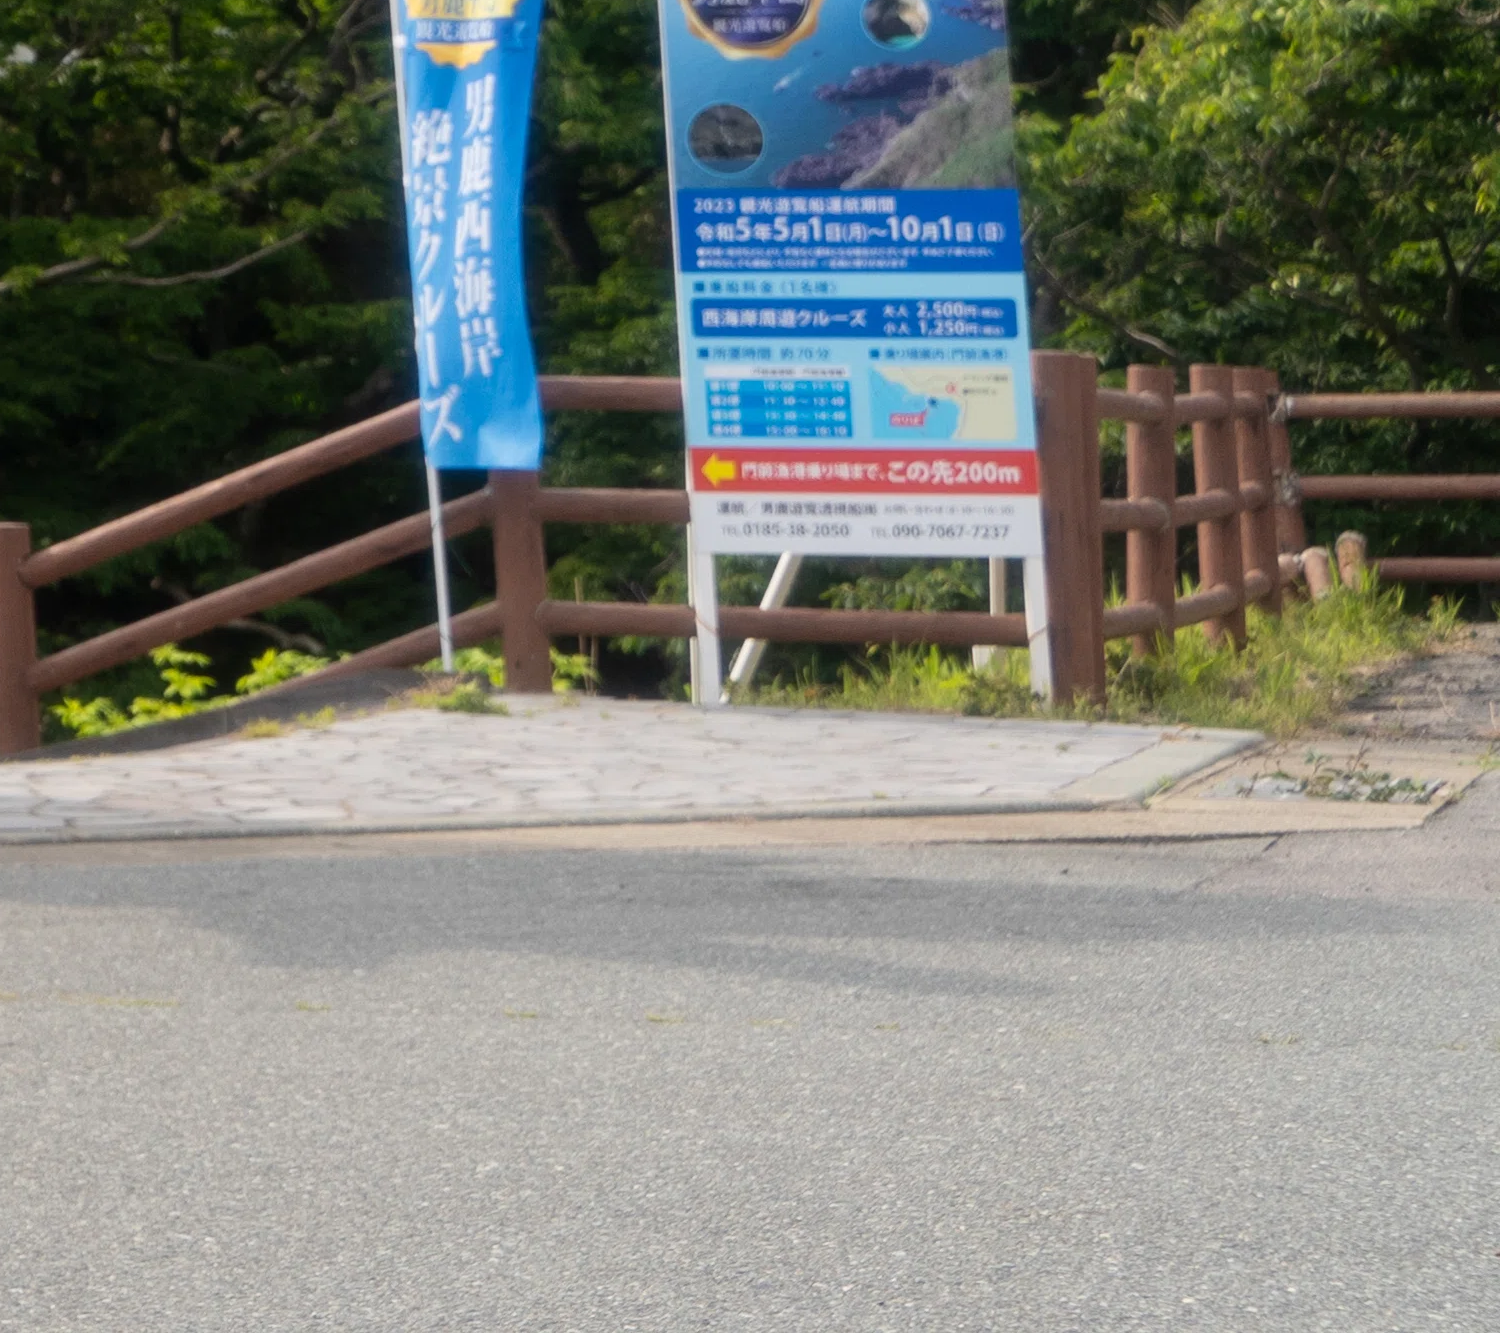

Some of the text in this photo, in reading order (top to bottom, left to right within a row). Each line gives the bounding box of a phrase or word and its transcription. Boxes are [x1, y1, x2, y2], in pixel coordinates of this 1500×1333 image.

[412, 108, 462, 450] 絶景クルーズ
[453, 73, 502, 378] 男鹿西海岸
[694, 197, 735, 213] 2023
[701, 307, 868, 329] 西海岸周遊クルーズ
